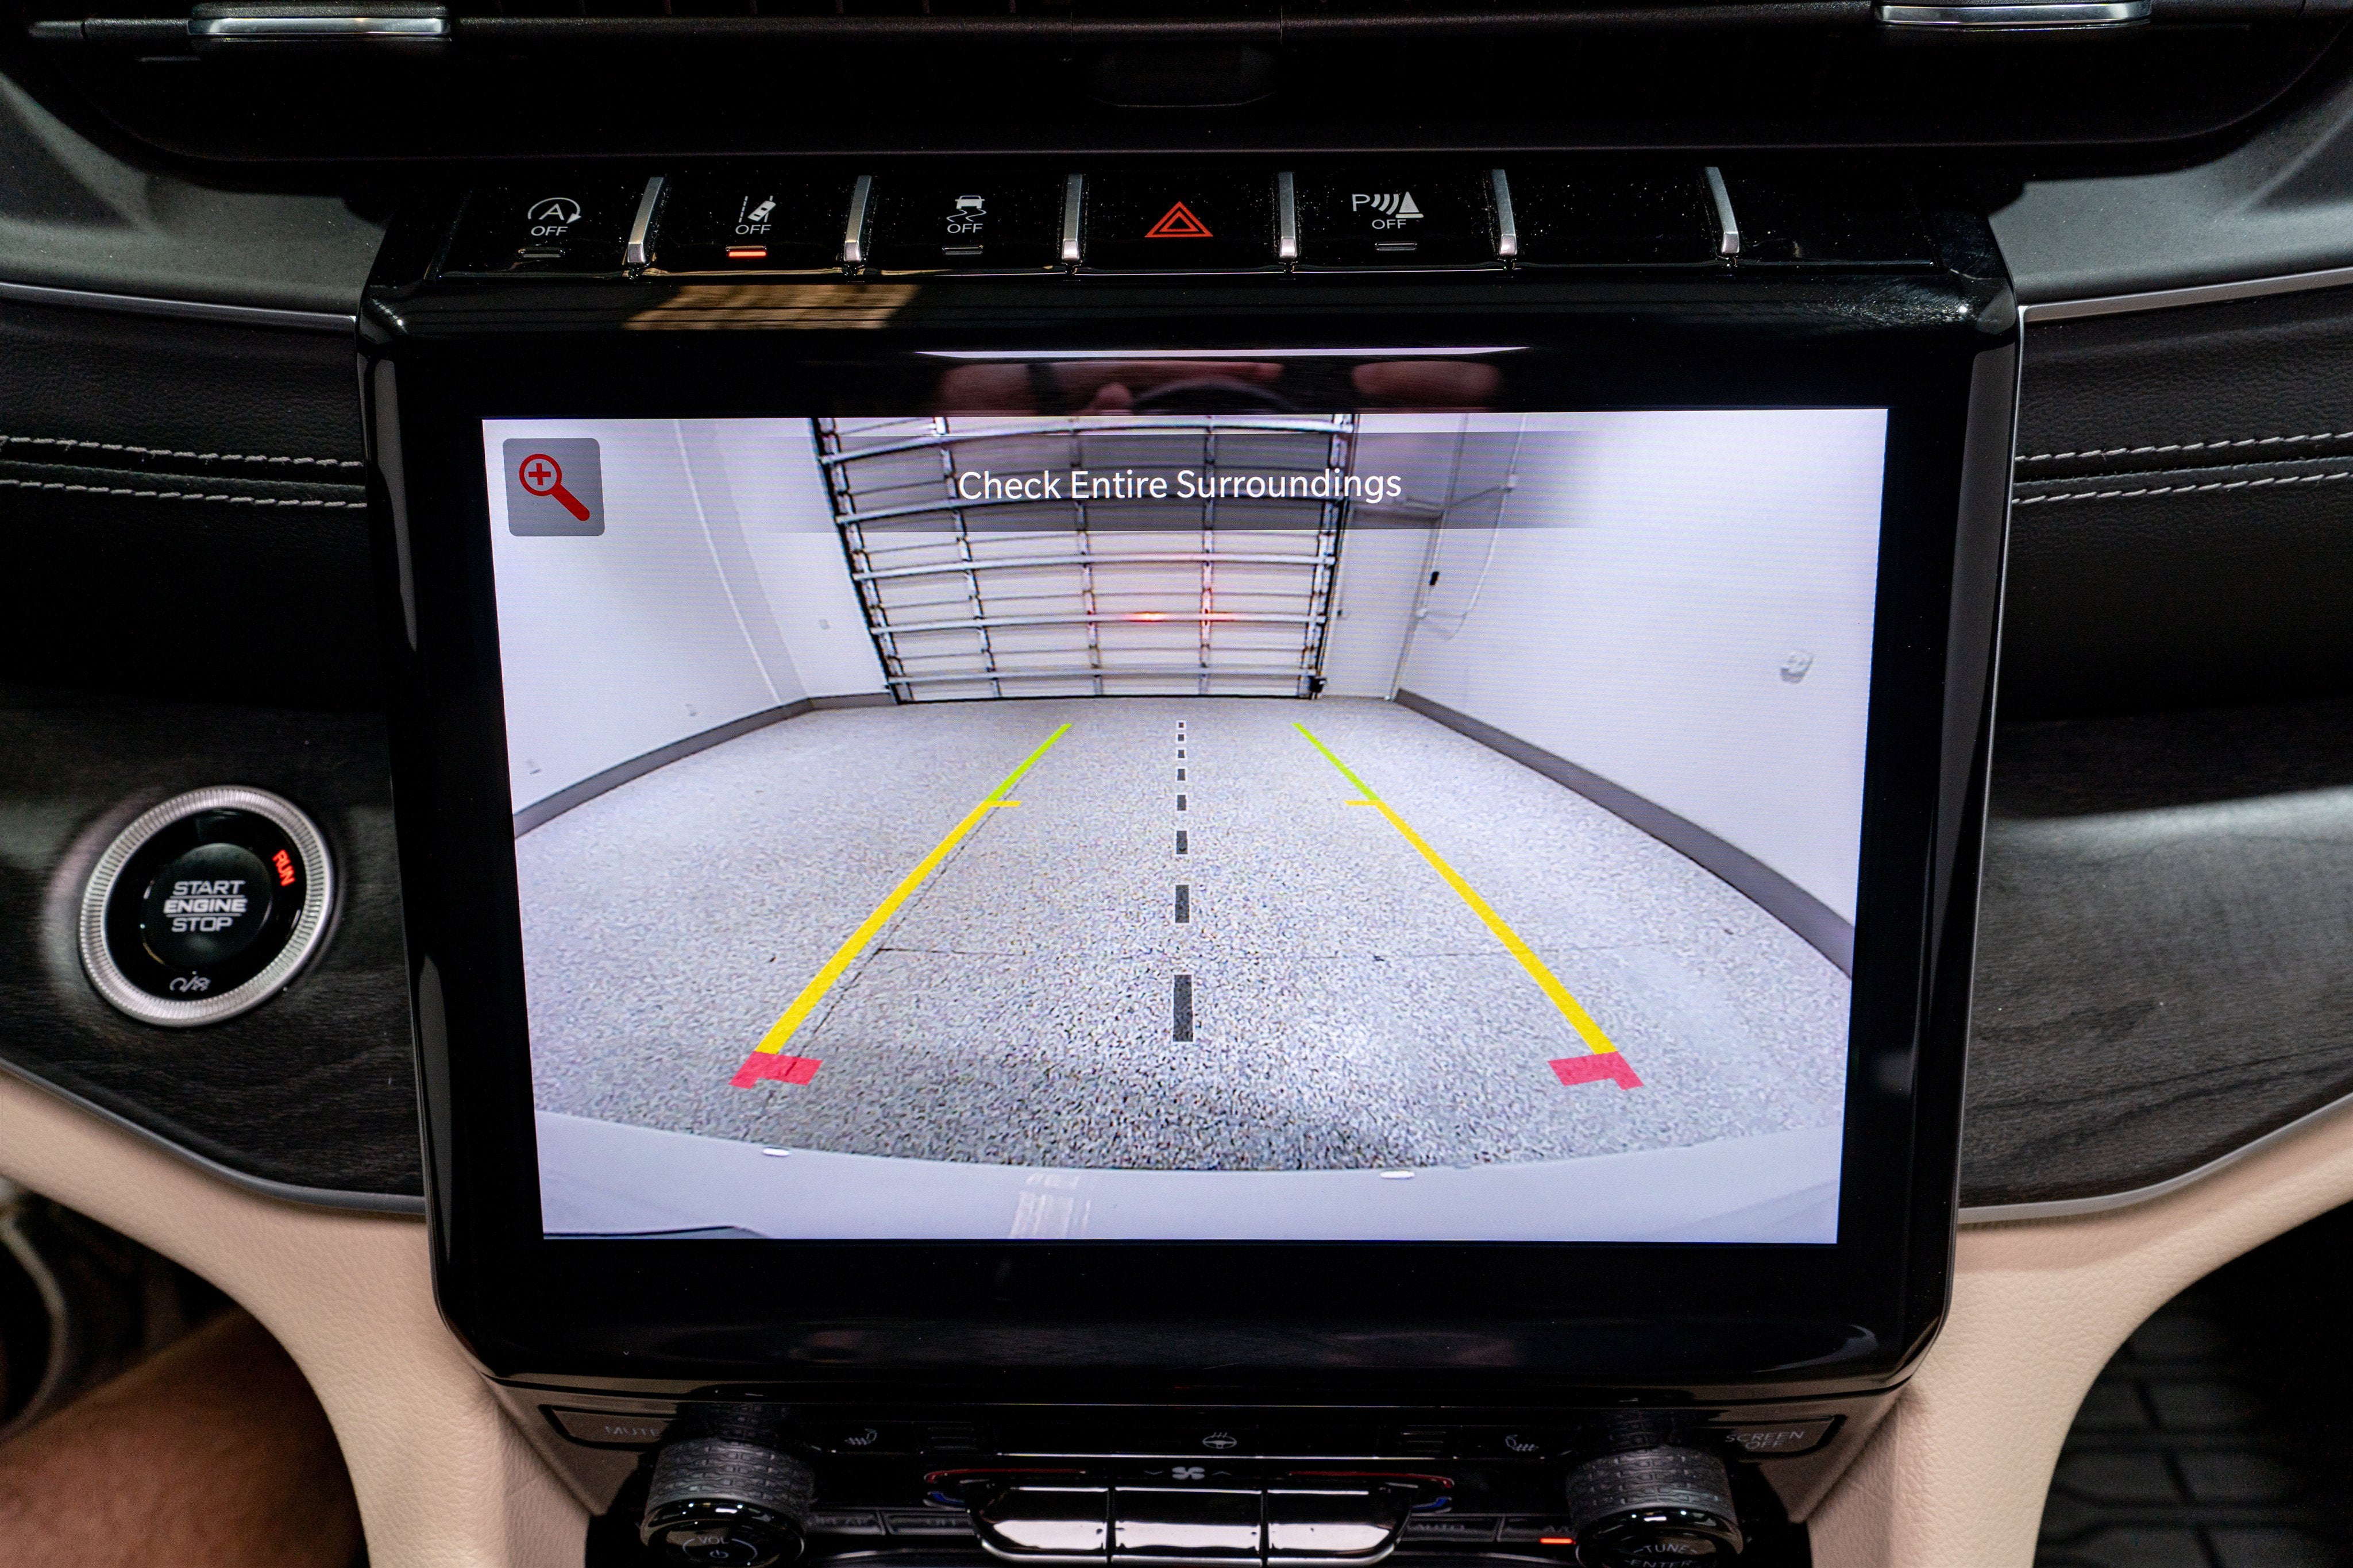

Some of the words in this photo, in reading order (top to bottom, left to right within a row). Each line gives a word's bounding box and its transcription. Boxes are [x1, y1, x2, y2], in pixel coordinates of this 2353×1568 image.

[1352, 194, 1370, 211] P
[539, 203, 565, 220] A
[735, 224, 772, 235] OFF
[947, 223, 983, 234] OFF
[1371, 219, 1407, 230] OFF
[530, 226, 568, 236] OFF
[958, 470, 1062, 499] Check
[1070, 470, 1168, 499] Entire
[1176, 469, 1402, 503] Surroundings
[272, 849, 296, 886] RUN
[172, 880, 246, 895] START
[163, 898, 248, 914] ENGINE
[171, 917, 233, 932] STOP
[1725, 1431, 1804, 1442] SCREEN
[1745, 1439, 1784, 1450] OFF
[697, 1536, 729, 1544] VOL
[1643, 1543, 1690, 1554] TUNE
